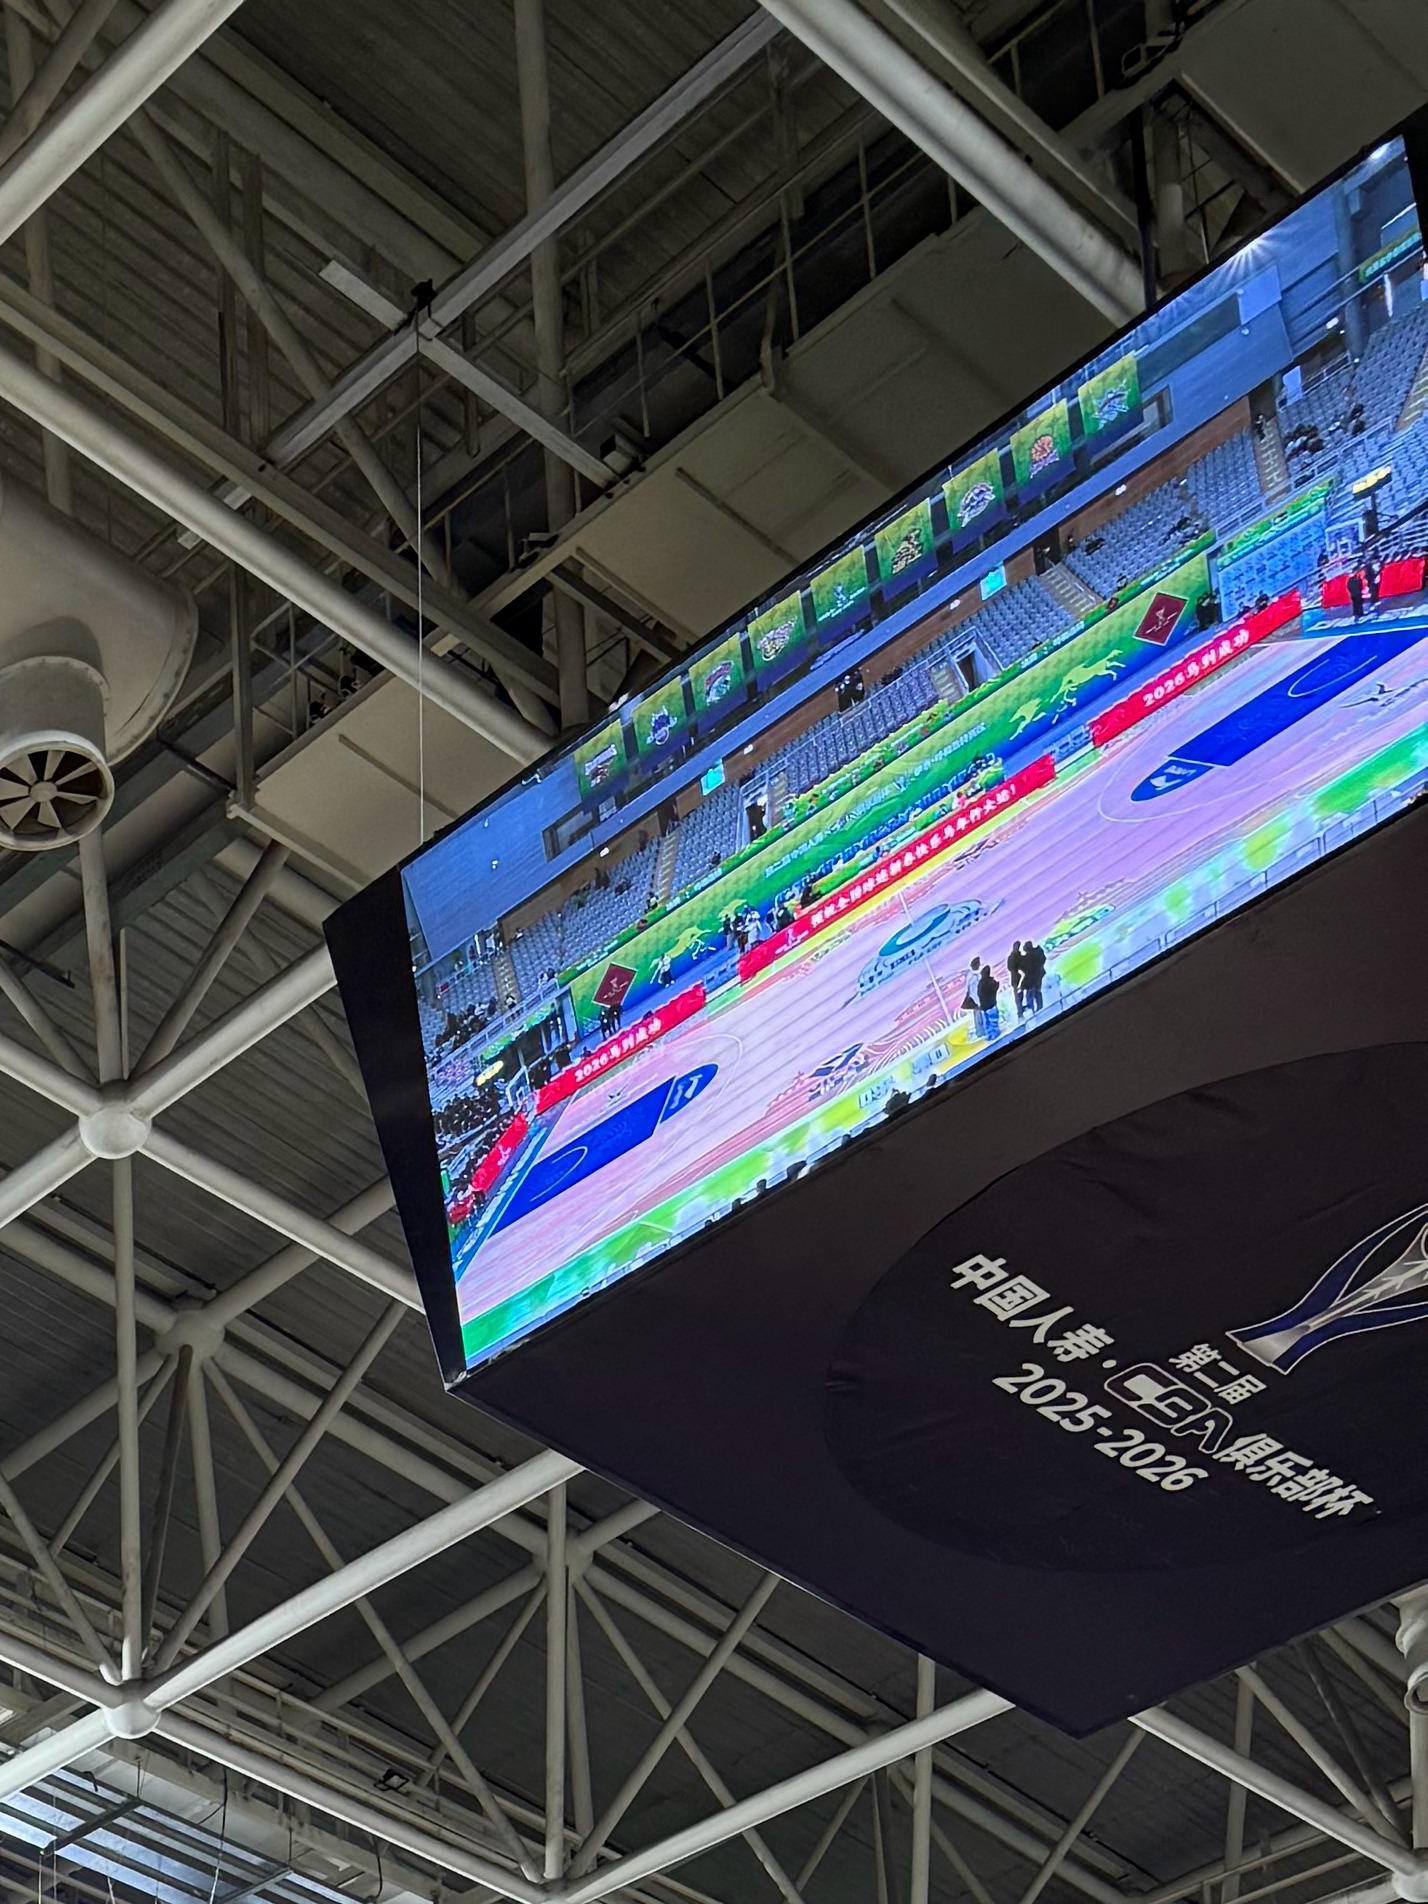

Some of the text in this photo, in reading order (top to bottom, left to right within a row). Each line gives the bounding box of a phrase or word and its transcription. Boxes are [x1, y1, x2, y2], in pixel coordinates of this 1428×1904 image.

[1169, 1343, 1266, 1405] 第二届
[994, 1363, 1208, 1492] 2025-2026
